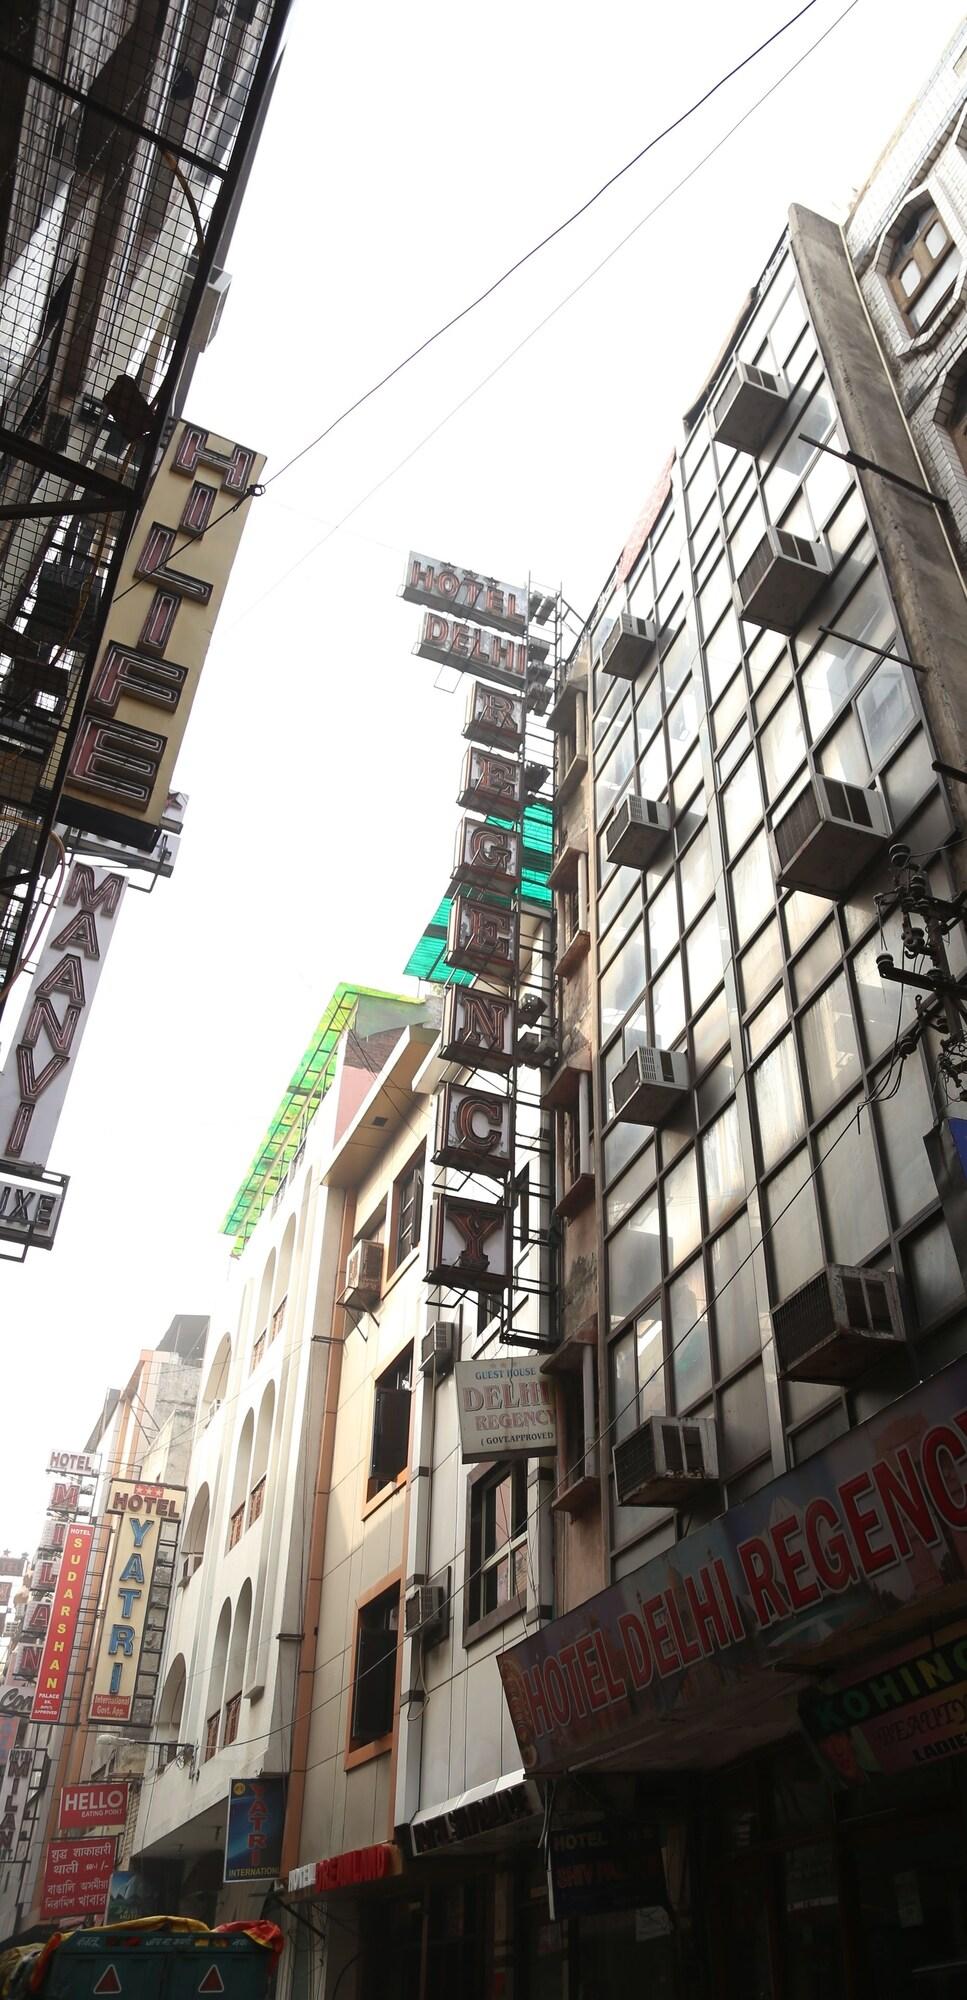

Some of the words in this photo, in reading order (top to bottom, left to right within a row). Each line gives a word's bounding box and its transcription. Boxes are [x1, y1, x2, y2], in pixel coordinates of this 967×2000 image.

[410, 560, 526, 625] HOTEL
[65, 424, 256, 812] HILIFE
[425, 614, 527, 675] DELHI
[449, 694, 518, 1269] REGENCY
[5, 862, 125, 1158] MAANVI
[475, 1369, 503, 1380] GUEST
[507, 1367, 536, 1378] HOUSE
[462, 1381, 550, 1412] DELHI
[50, 1451, 92, 1473] HOTEL
[113, 1491, 180, 1518] HOTEL
[71, 1528, 91, 1536] HOTEL
[520, 1630, 626, 1736] HOTEL
[619, 1558, 745, 1690] DELHI
[738, 1411, 967, 1629] REGENC
[47, 1539, 82, 1689] SUDARSHAN
[108, 1517, 154, 1694] YATRI
[65, 1790, 123, 1811] HELLO
[81, 1810, 103, 1818] EATING
[104, 1808, 122, 1816] POINT
[73, 1843, 111, 1857] शाकाहारी
[54, 1860, 78, 1875] थाली
